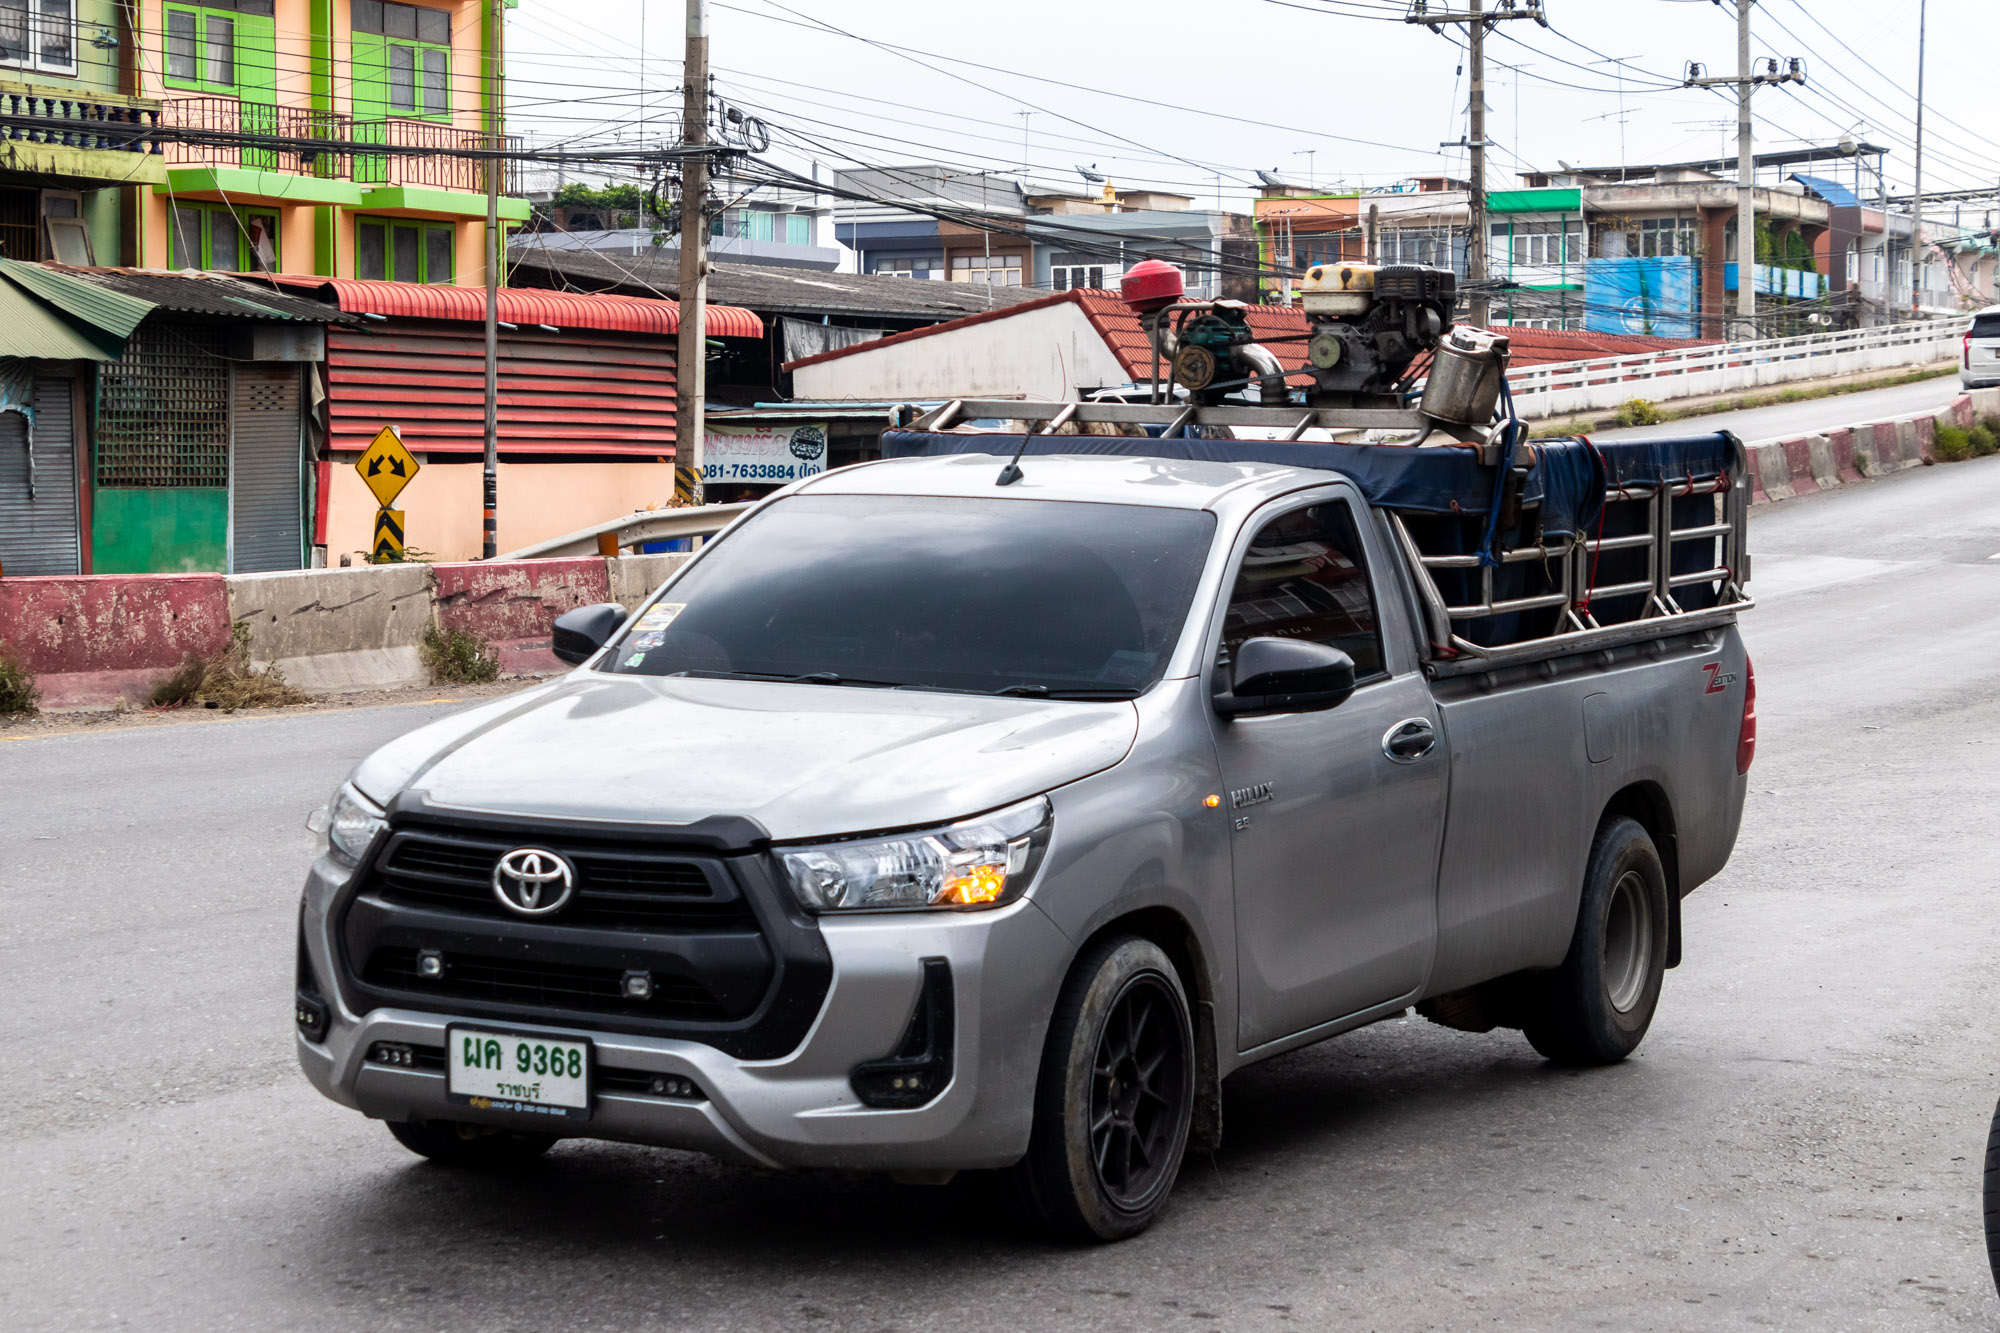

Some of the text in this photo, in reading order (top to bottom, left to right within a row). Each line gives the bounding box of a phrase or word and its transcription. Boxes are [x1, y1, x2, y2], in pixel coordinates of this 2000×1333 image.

[703, 463, 795, 479] 081-7633884
[1231, 781, 1273, 808] HILUX
[464, 1037, 582, 1079] ผค 9368
[496, 1082, 541, 1102] ราชบุรี
